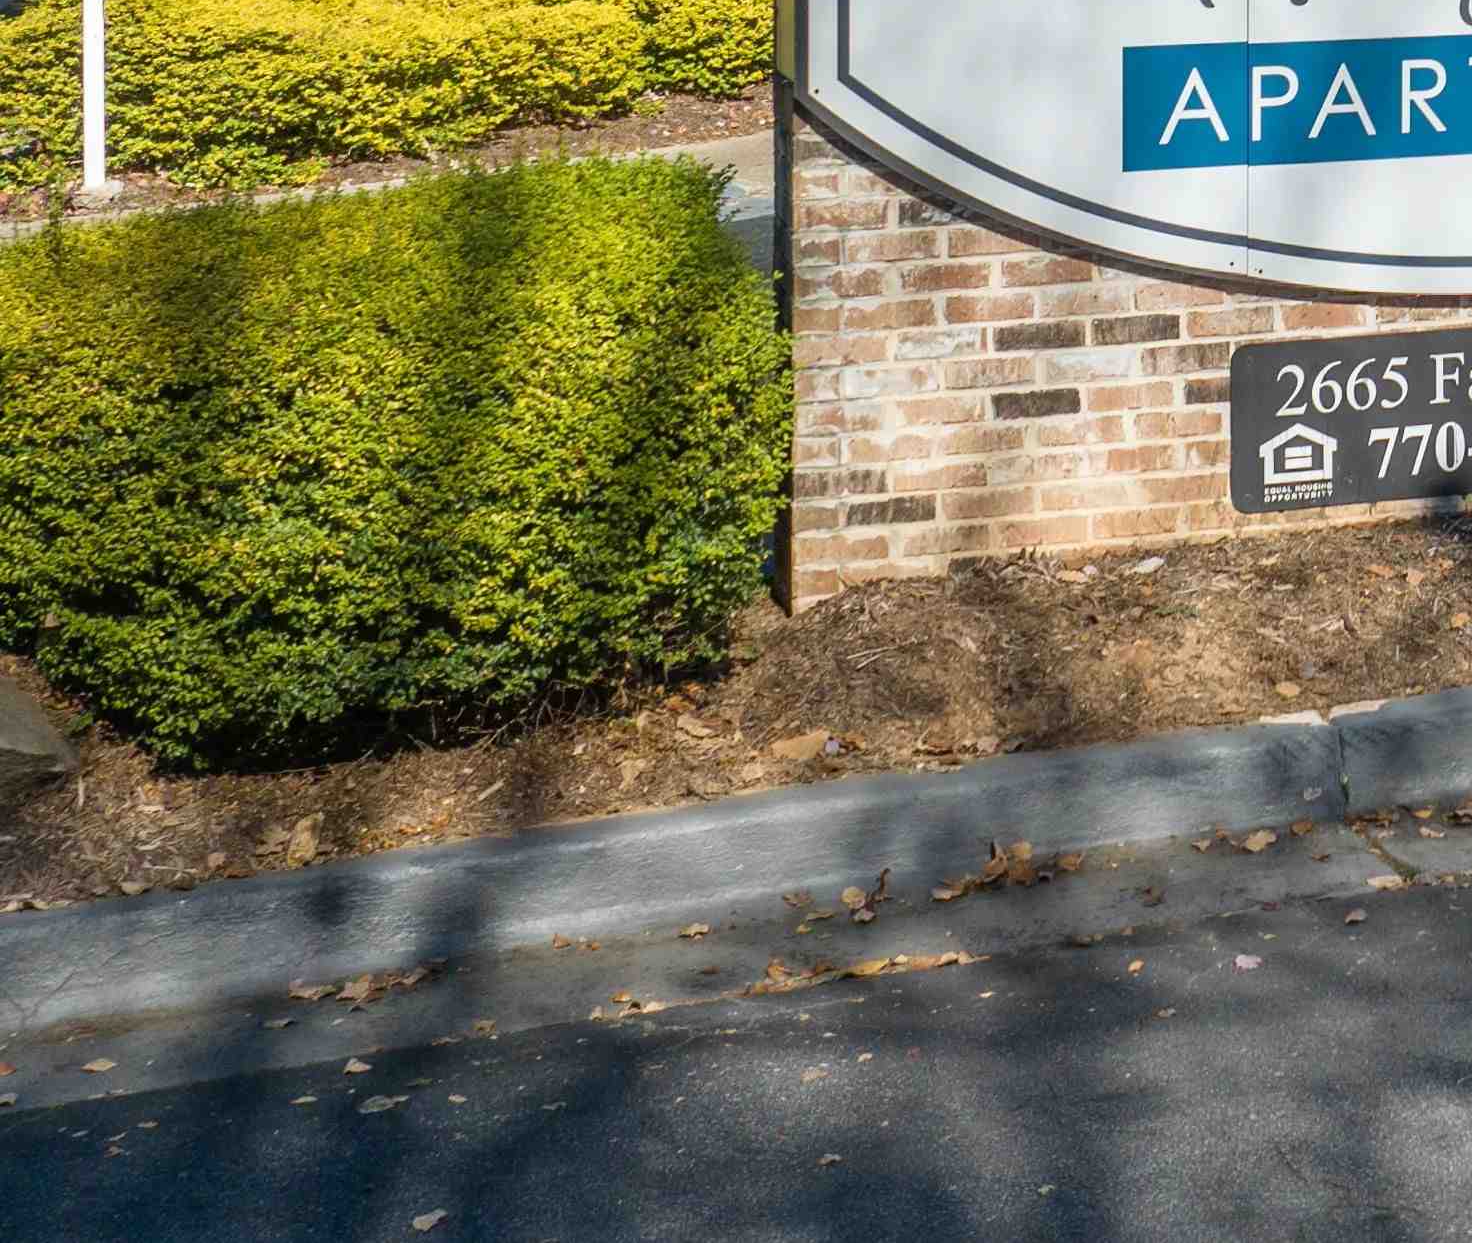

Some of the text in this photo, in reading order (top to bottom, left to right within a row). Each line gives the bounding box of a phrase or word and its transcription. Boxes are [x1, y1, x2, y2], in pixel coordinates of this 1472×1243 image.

[1275, 356, 1410, 417] 2665
[1263, 480, 1333, 495] EQUAL HOUSING
[1263, 489, 1334, 503] OPPORTUNITY
